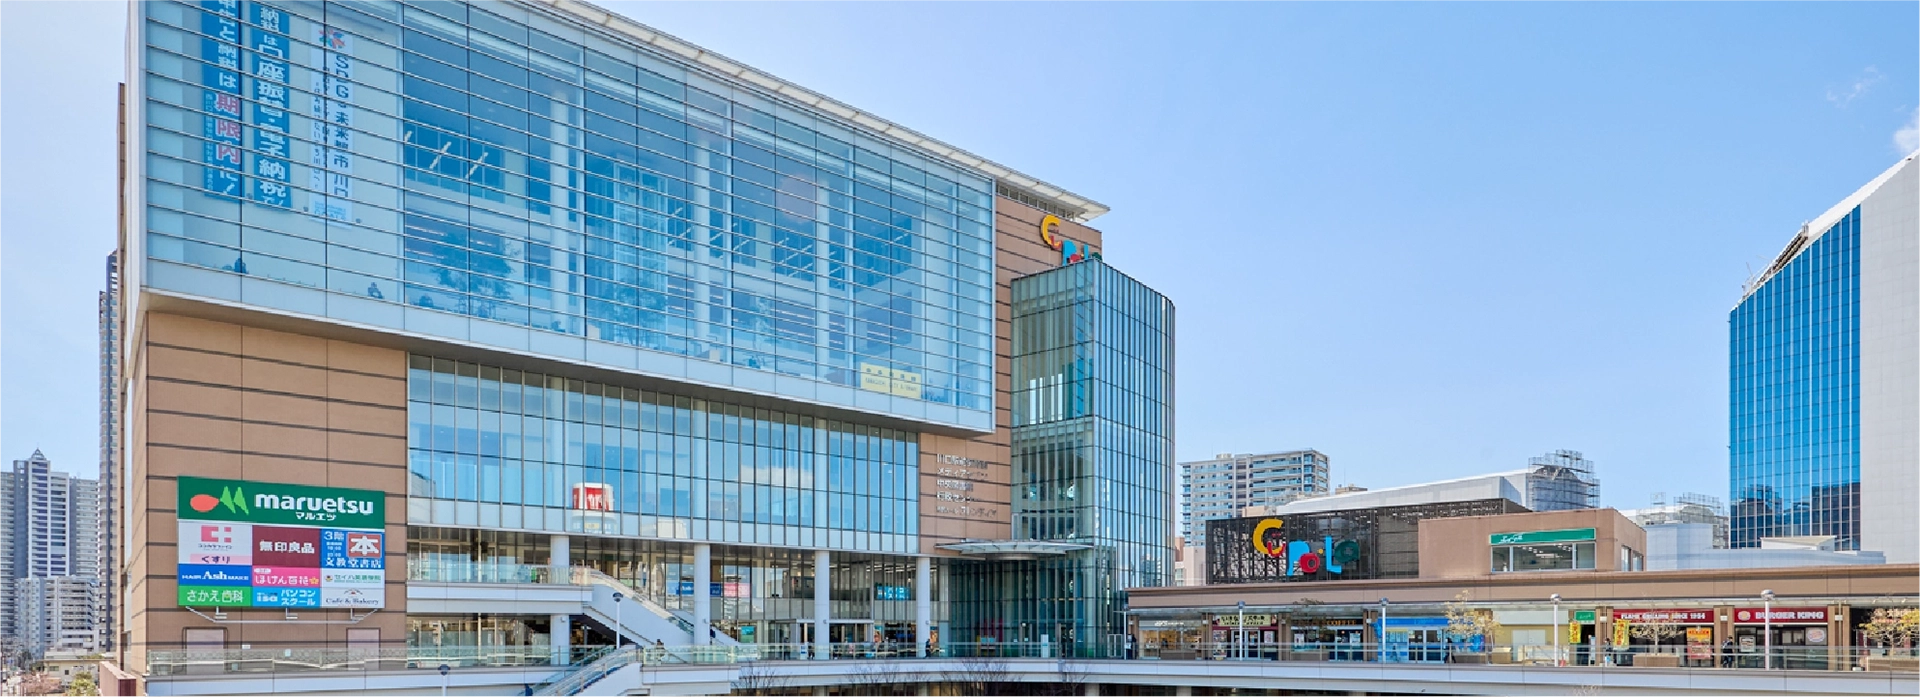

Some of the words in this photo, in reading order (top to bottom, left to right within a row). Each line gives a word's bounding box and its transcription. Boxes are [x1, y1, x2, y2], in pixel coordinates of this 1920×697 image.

[255, 493, 374, 515] maruetsu
[296, 511, 337, 521] マルエツ
[259, 540, 315, 554] 無印良品
[350, 535, 379, 556] 本
[201, 555, 231, 564] くすり
[202, 570, 227, 580] Ash
[186, 589, 243, 603] さかえ歯科
[281, 589, 316, 597] パソコン
[281, 597, 316, 606] スクール
[1797, 611, 1824, 620] KING
